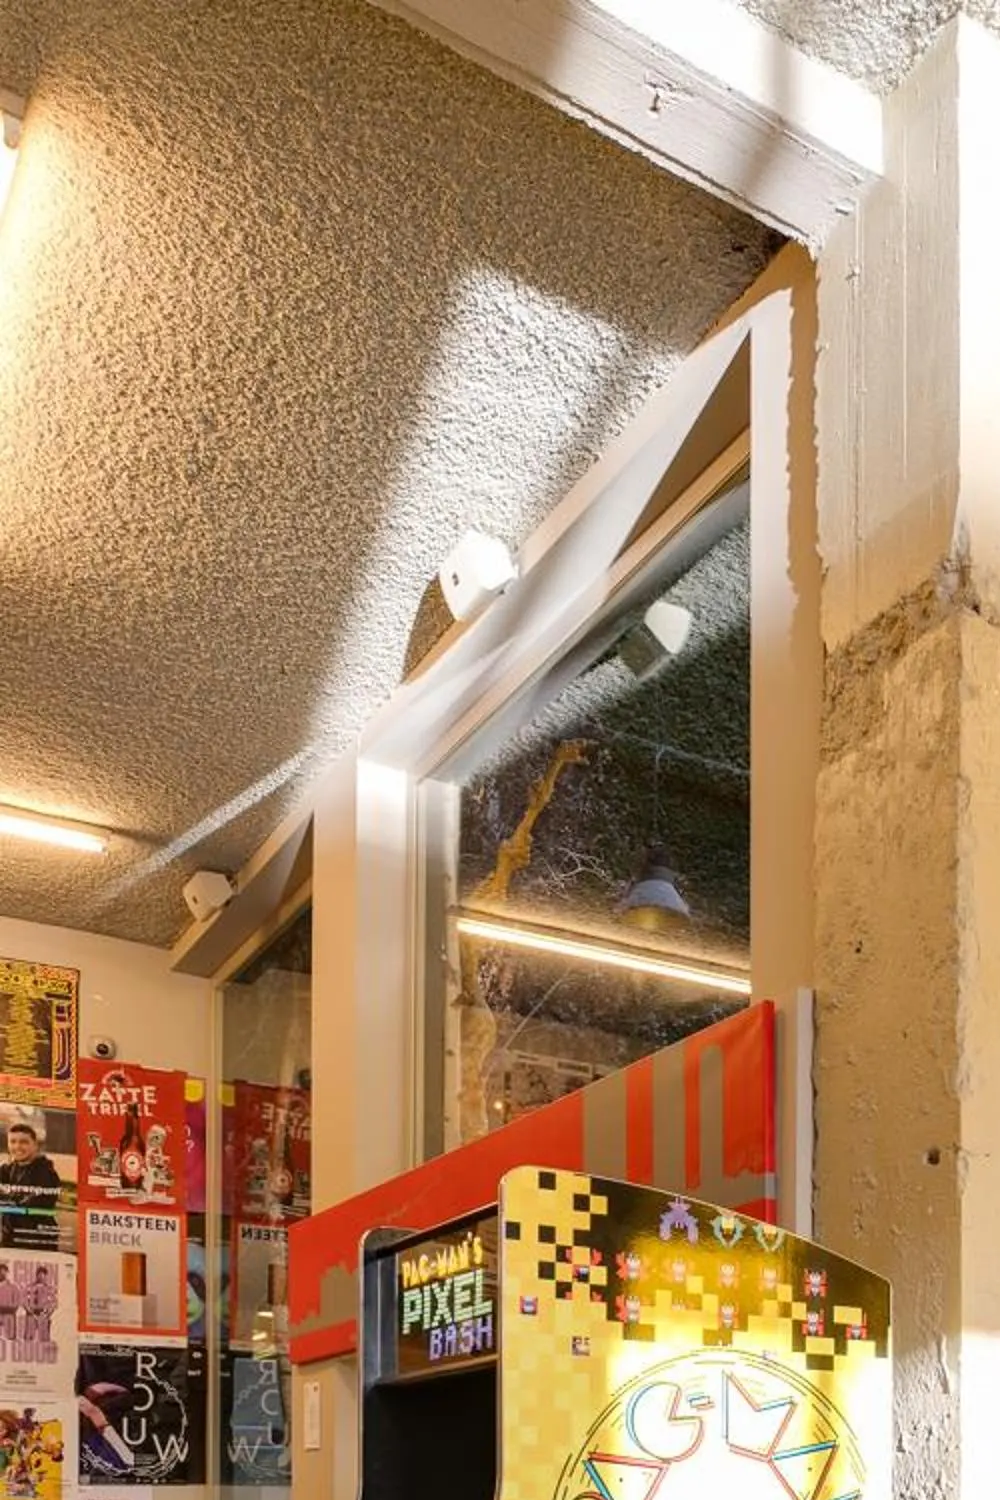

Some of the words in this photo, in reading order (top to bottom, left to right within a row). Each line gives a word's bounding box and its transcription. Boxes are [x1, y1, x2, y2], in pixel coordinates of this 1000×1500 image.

[88, 1101, 154, 1117] TRIPL
[89, 1212, 177, 1232] BAKSTEEN
[89, 1230, 143, 1247] BRICK
[402, 1267, 493, 1335] PIXEL
[429, 1315, 493, 1362] BASH
